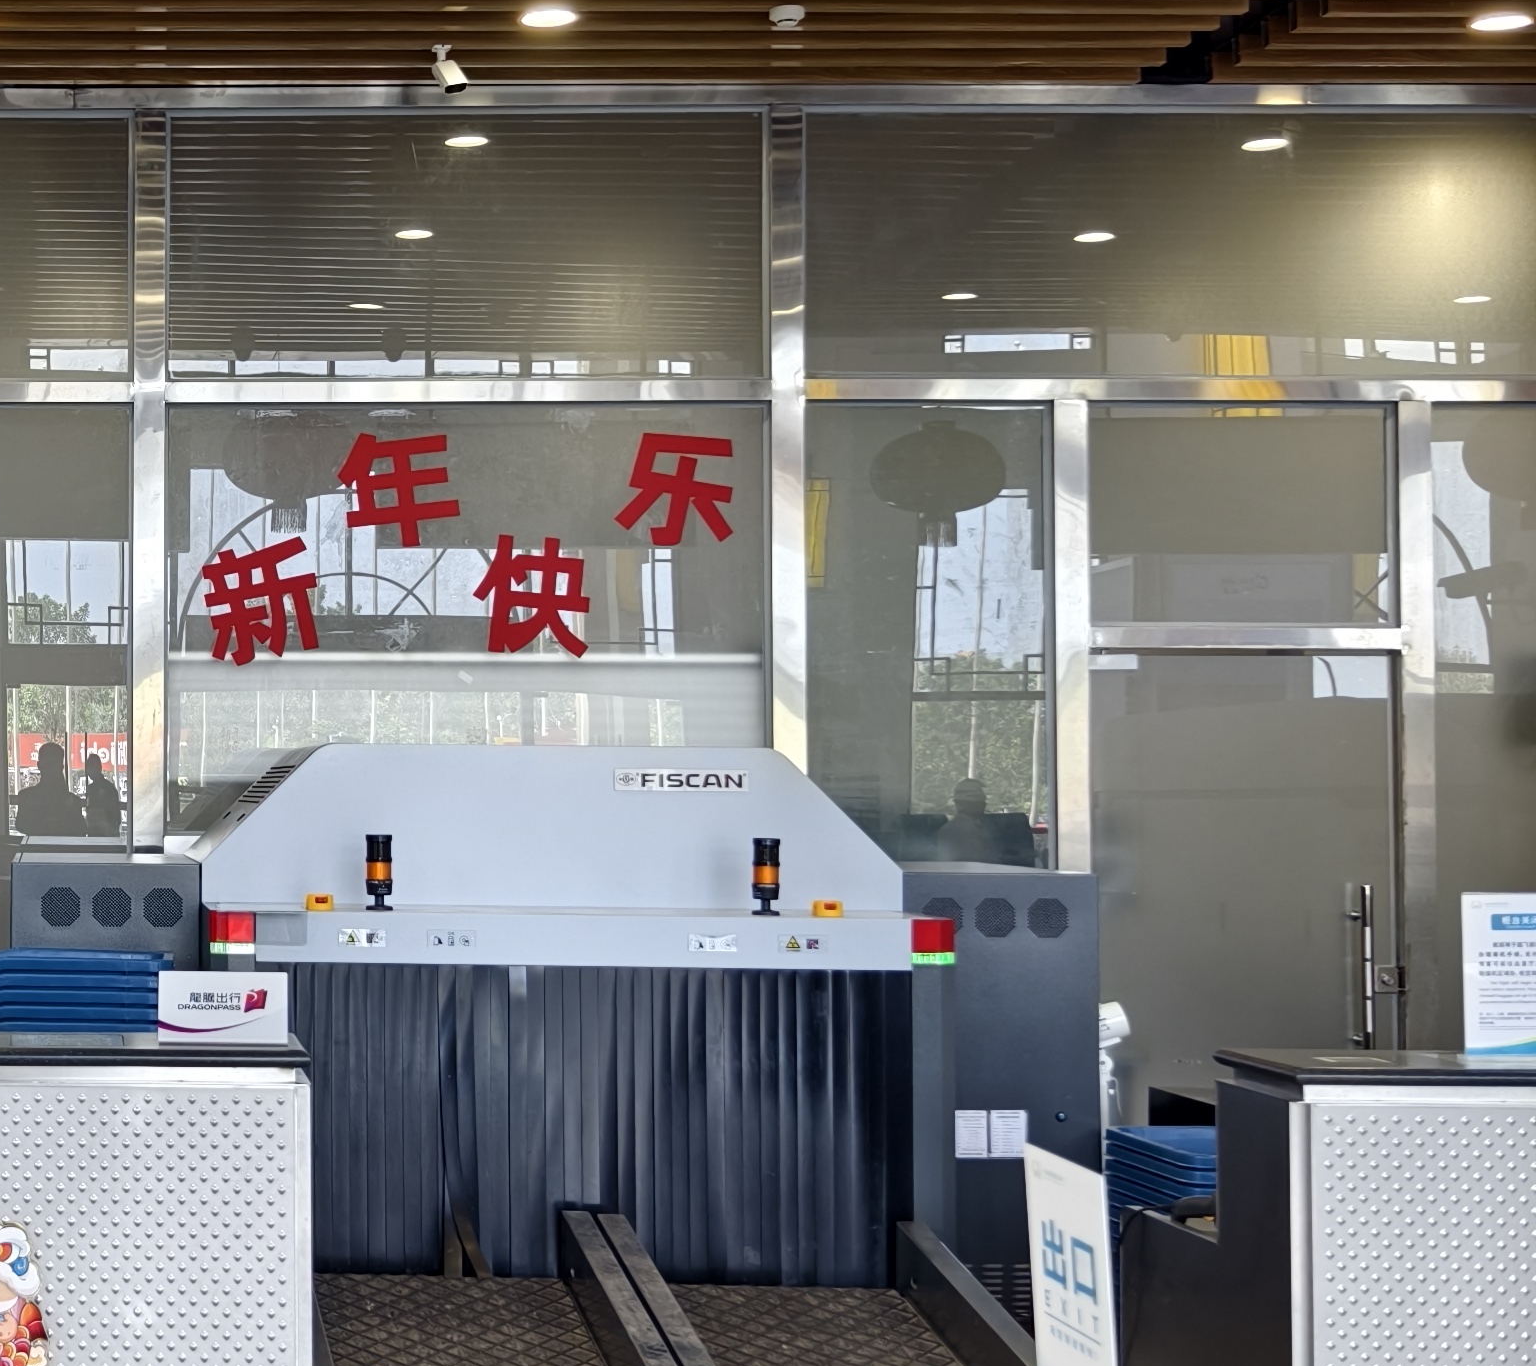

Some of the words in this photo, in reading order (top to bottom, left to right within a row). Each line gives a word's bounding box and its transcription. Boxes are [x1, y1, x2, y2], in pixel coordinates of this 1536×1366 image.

[639, 772, 744, 789] FISCAN
[176, 1003, 242, 1011] DRAGONPASS
[1040, 1218, 1099, 1308] 出口
